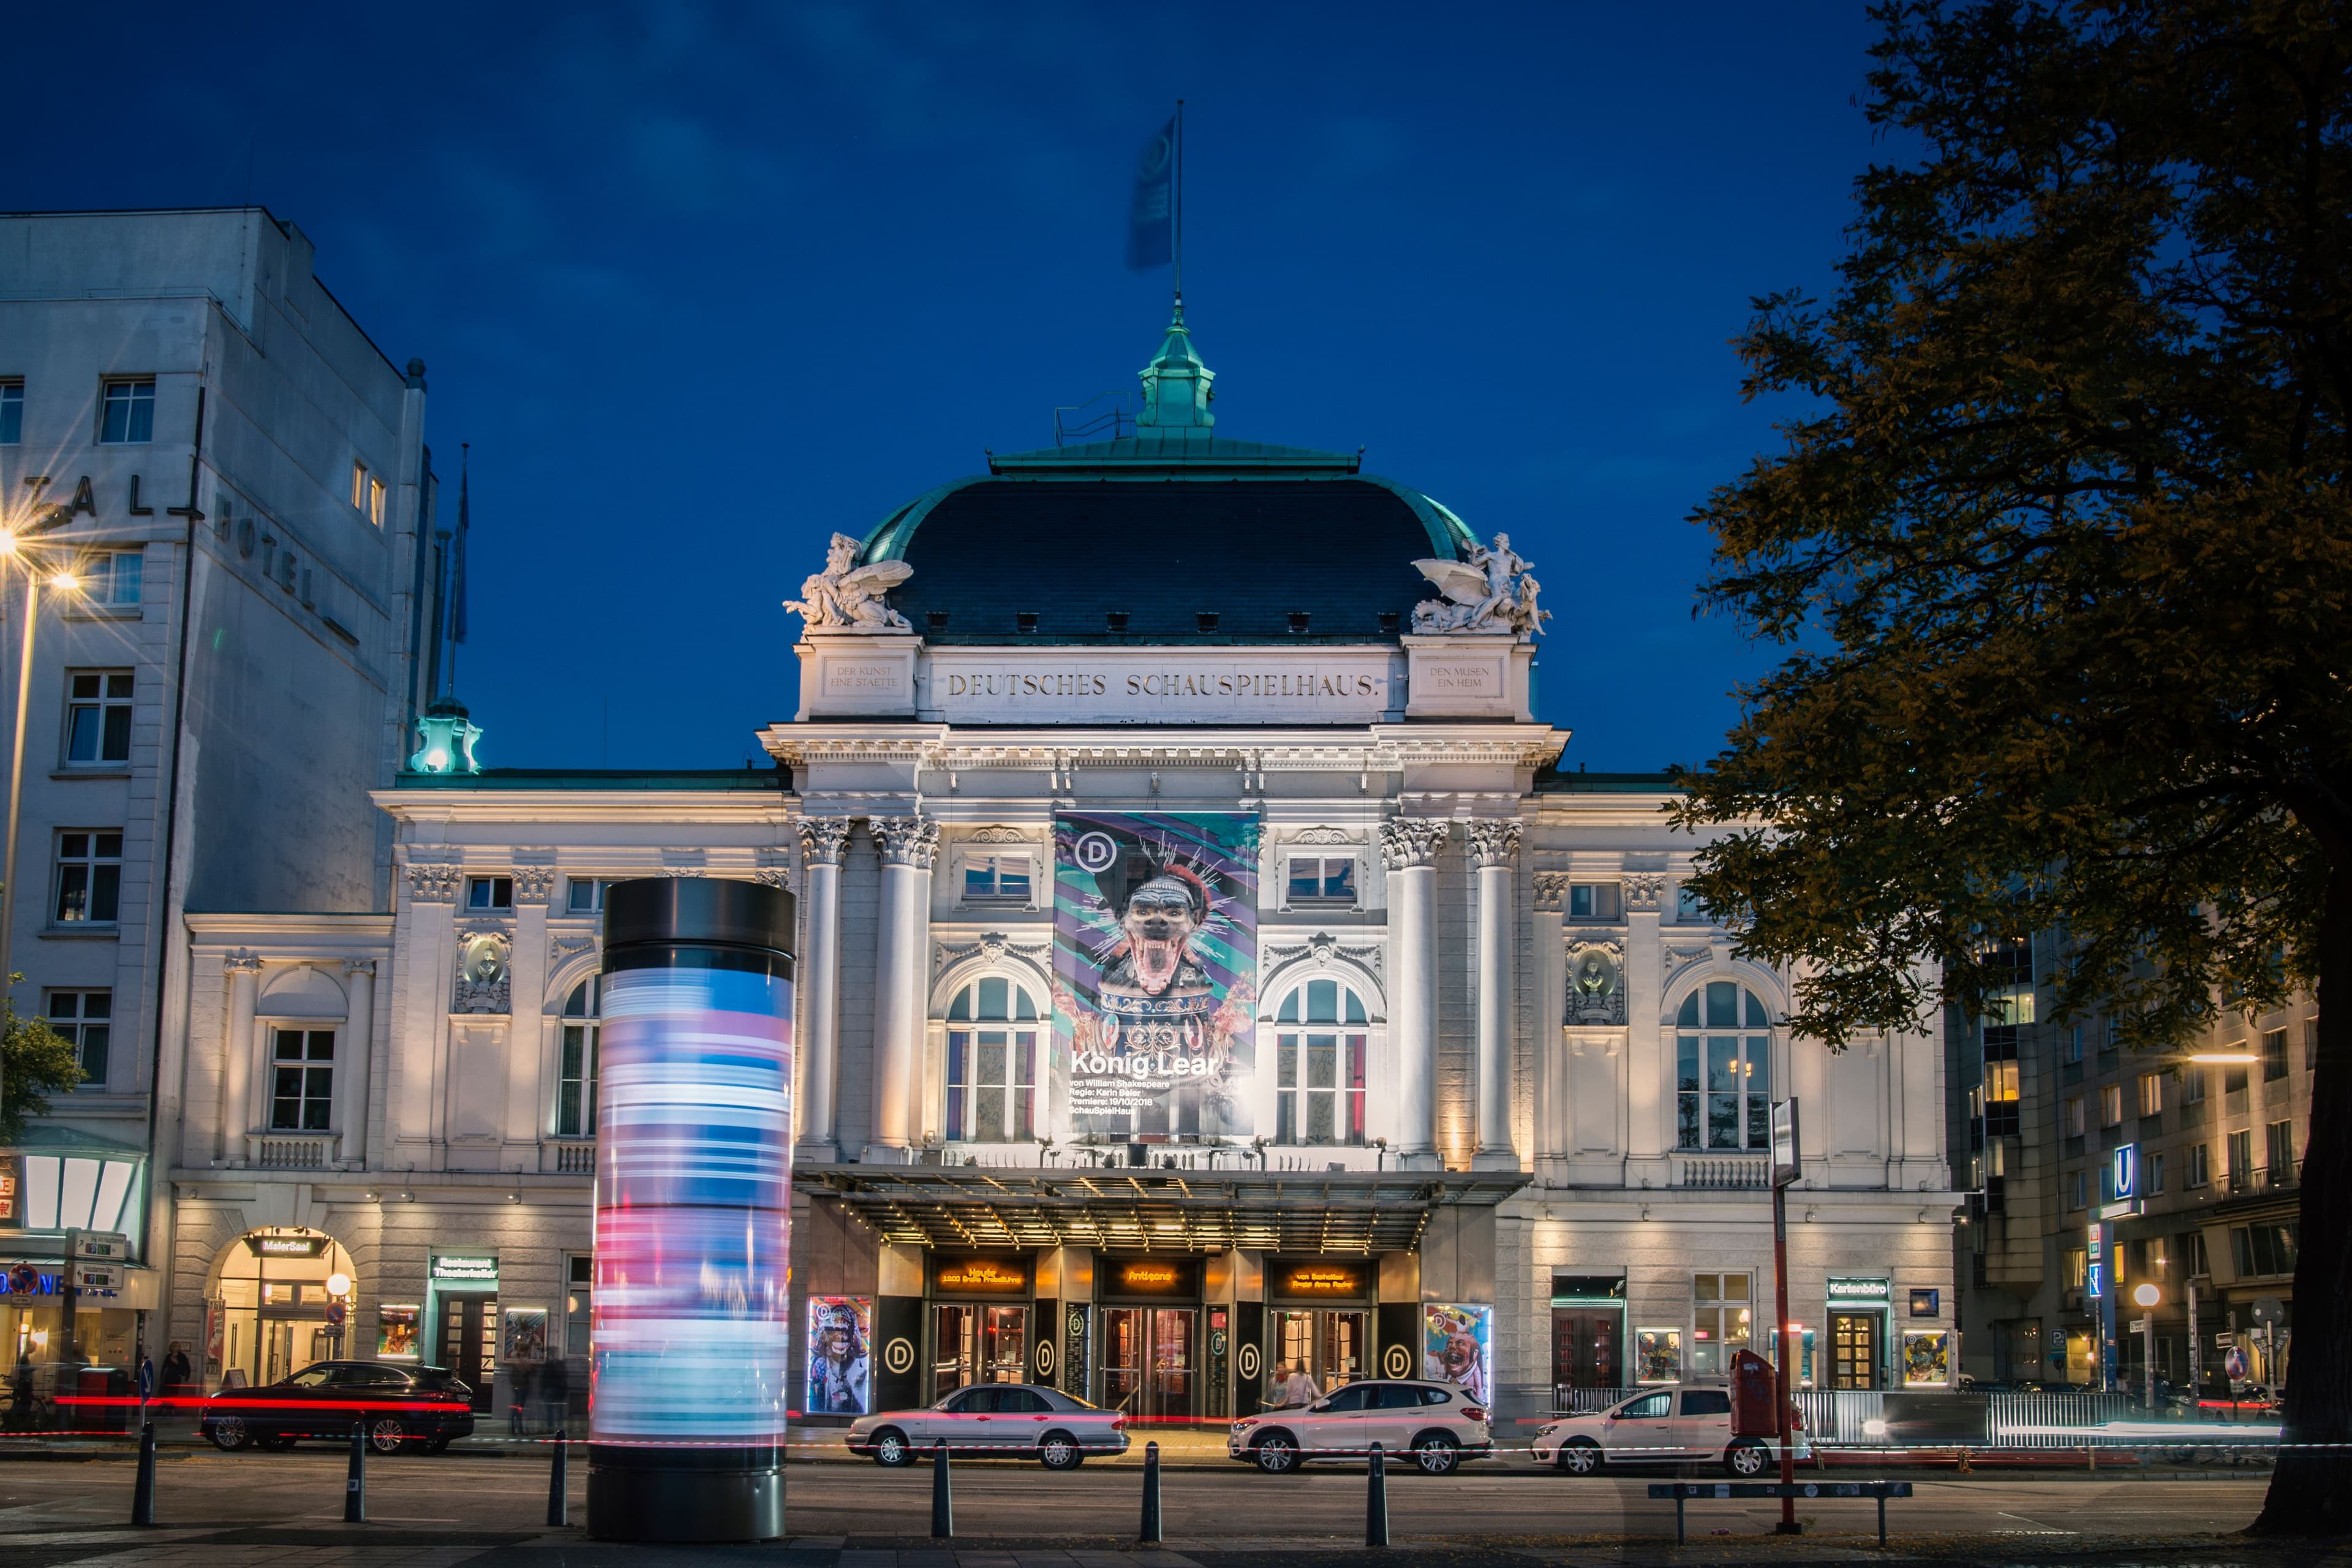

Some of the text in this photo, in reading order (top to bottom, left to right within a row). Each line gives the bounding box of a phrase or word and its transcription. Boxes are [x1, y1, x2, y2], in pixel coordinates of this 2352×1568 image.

[215, 492, 315, 611] HOTEL
[837, 666, 892, 676] DER KUNST
[1430, 667, 1489, 676] DEN MUSEN
[831, 677, 897, 687] EINE STAETTE
[948, 674, 1106, 696] DEUTSCHES
[1438, 678, 1481, 687] EIN HEIM
[1071, 1050, 1218, 1080] König Lear
[1085, 1079, 1115, 1088] William
[1117, 1080, 1170, 1089] Shakespeare
[1069, 1089, 1095, 1098] Regie:
[1119, 1089, 1141, 1098] Beier
[1109, 1098, 1153, 1107] 19/10/2018
[1068, 1107, 1136, 1116] SchauSpielHaus
[2117, 1150, 2131, 1194] U
[969, 1268, 997, 1278] Heute
[1129, 1271, 1171, 1281] Antigone
[1830, 1283, 1887, 1294] Kartenbüro
[2052, 1332, 2062, 1344] P
[894, 1346, 907, 1365] D
[1392, 1352, 1404, 1372] D
